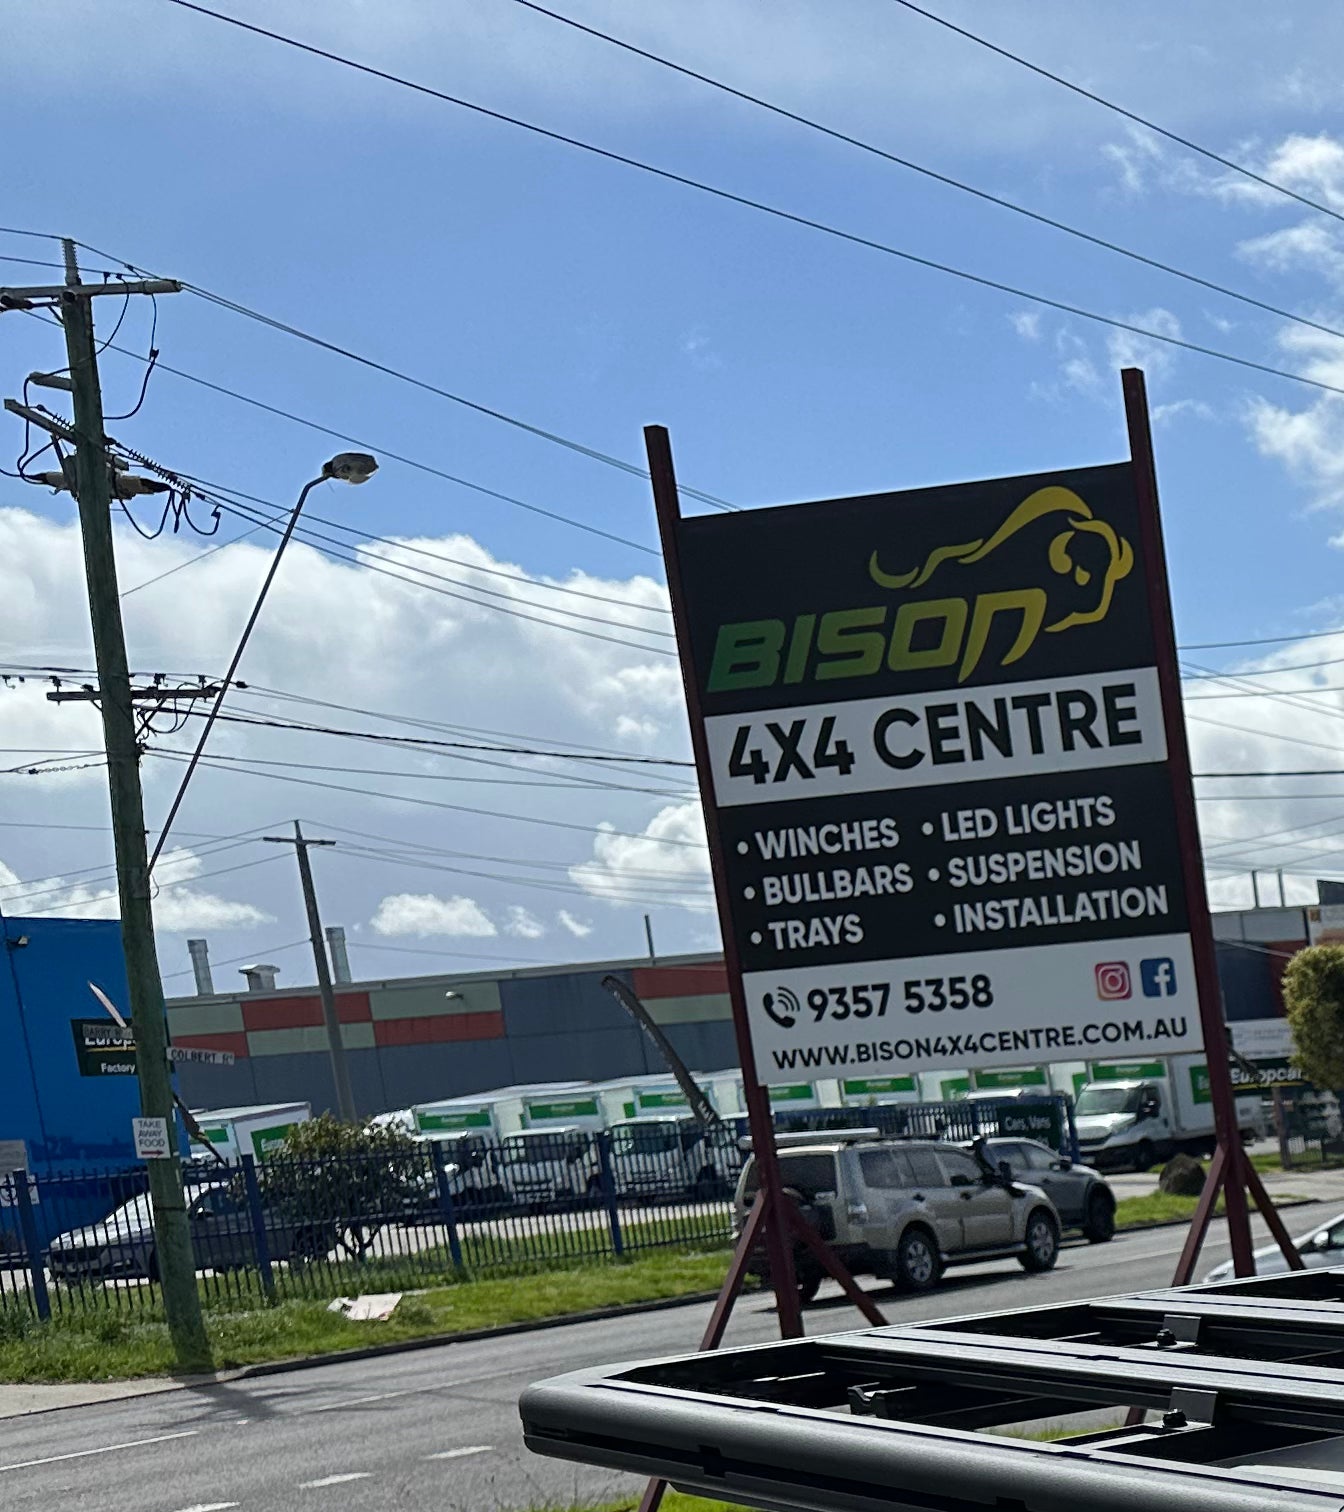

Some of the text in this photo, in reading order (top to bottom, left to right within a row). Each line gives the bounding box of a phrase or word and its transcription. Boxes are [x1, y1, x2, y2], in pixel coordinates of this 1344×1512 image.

[706, 588, 1047, 692] BISON
[728, 682, 1143, 784] 4X4 CENTRE
[754, 818, 900, 860] WINCHES
[941, 795, 1116, 841] LED LIGHTS
[763, 863, 913, 906] BULLBARS
[948, 840, 1142, 888] SUSPENSION
[953, 885, 1169, 934] INSTALLATION
[768, 914, 864, 951] TRAYS
[807, 974, 994, 1023] 9357 5358
[171, 1049, 216, 1065] COLBERT
[772, 1017, 1188, 1070] WWW.BISON4X4CENTRE.COM.AU
[138, 1121, 161, 1129] TAKE
[138, 1130, 162, 1138] AWAY
[138, 1139, 165, 1147] FOOD
